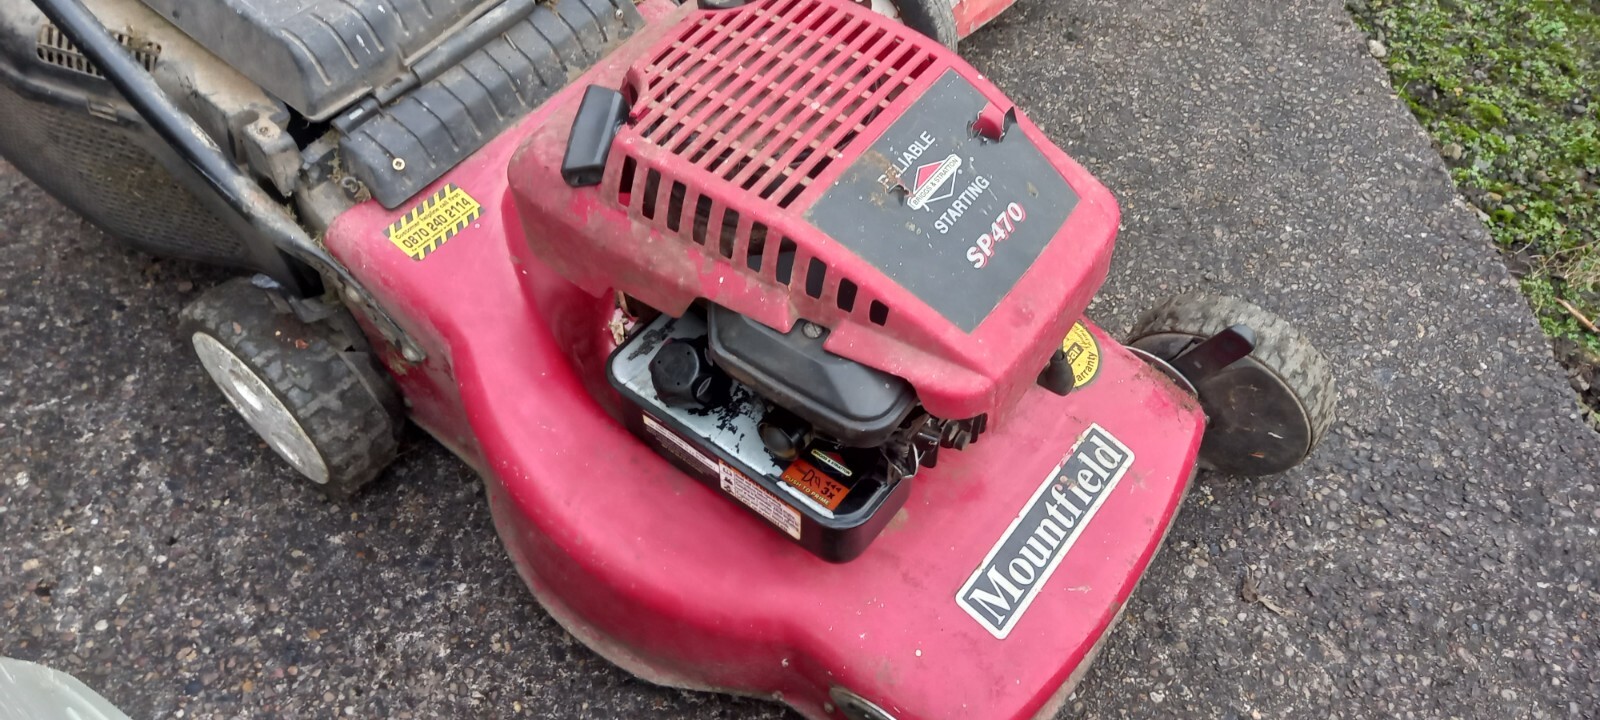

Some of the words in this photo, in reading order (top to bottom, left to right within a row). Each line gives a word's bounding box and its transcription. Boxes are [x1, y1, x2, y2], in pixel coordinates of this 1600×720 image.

[877, 131, 935, 189] RLIABLE
[912, 186, 933, 206] BRIGGS
[935, 158, 959, 184] STRATTON
[395, 221, 420, 240] Customer
[419, 207, 440, 222] helpline
[440, 200, 450, 209] call
[402, 228, 430, 249] 0870
[426, 214, 448, 232] 240
[445, 197, 471, 218] 2114
[934, 175, 990, 234] STARTING
[966, 202, 1026, 269] SP470
[1075, 351, 1098, 382] arranty
[785, 474, 802, 488] PUSH
[802, 484, 811, 493] TO
[811, 490, 830, 506] PRIME
[968, 434, 1123, 625] Mountfield
